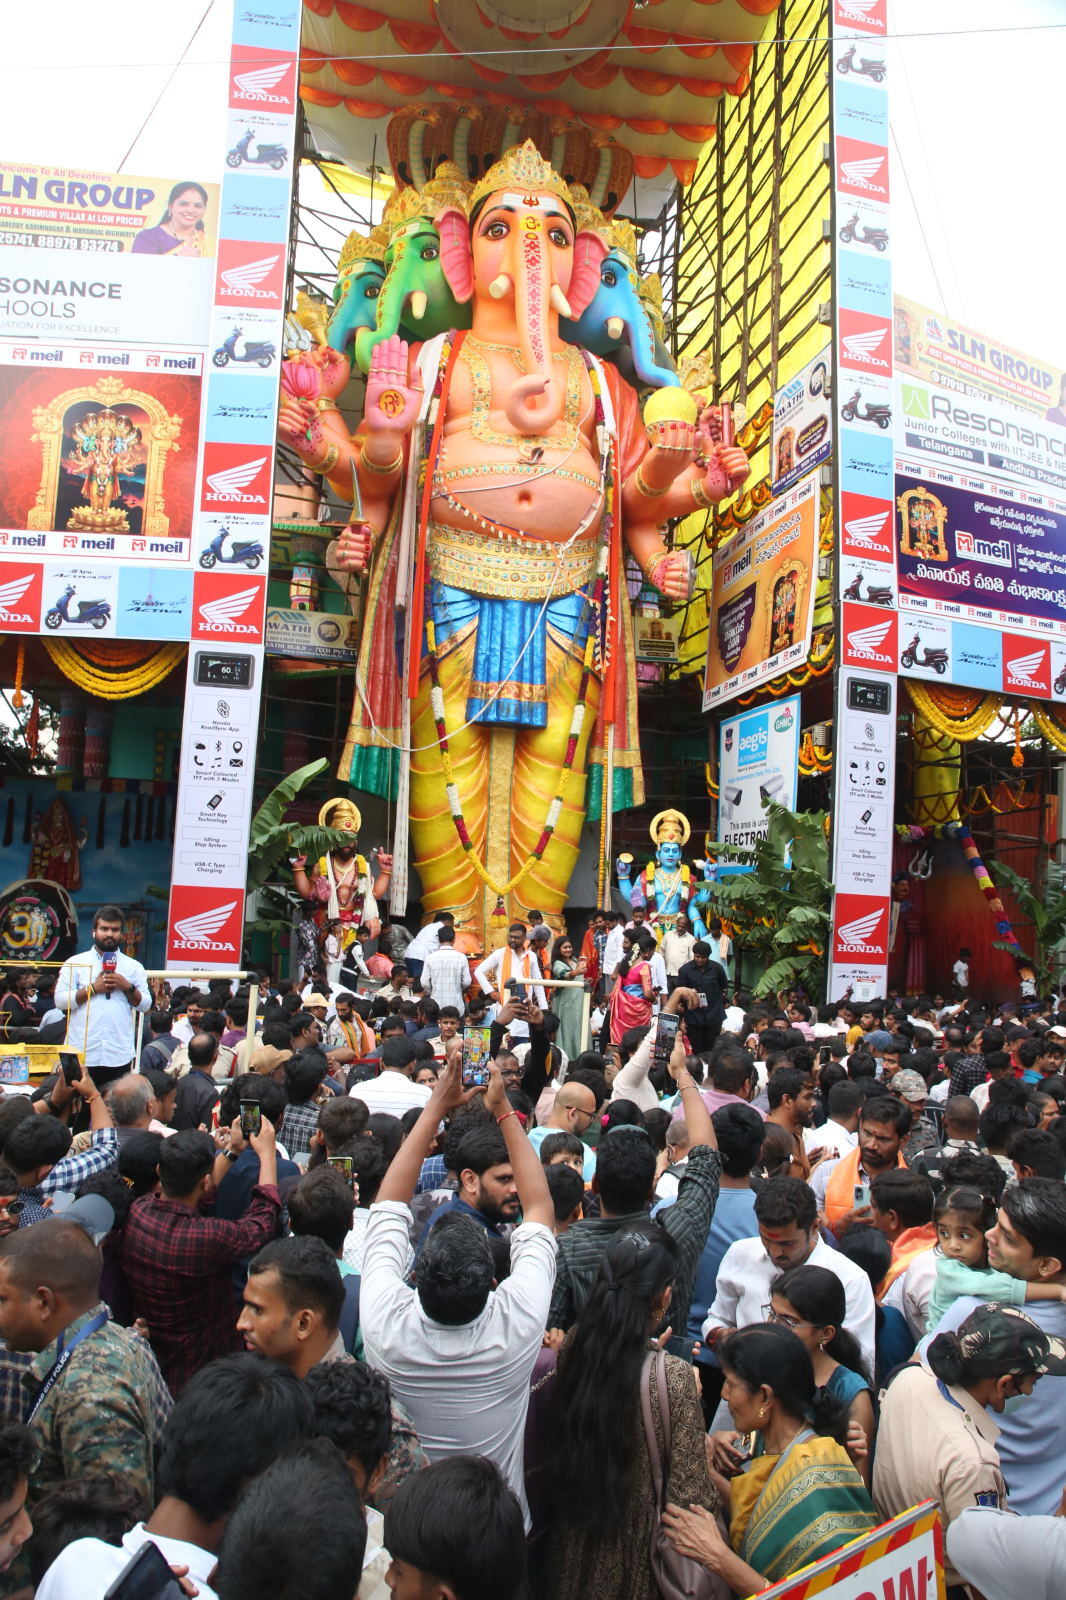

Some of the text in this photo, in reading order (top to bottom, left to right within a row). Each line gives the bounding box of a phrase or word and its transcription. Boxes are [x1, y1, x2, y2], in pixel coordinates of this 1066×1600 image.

[838, 9, 885, 27] HONDA
[232, 90, 291, 104] HONDA
[840, 176, 887, 194] HONDA
[44, 179, 155, 211] GROUP
[13, 207, 19, 216] &
[21, 208, 57, 219] PREMIUM
[60, 210, 86, 221] VILLAS
[98, 213, 115, 223] LOW
[116, 215, 143, 226] PRICES
[219, 287, 280, 299] HONDA
[36, 321, 56, 331] FOR
[58, 323, 121, 335] EXCELLENCE
[30, 350, 196, 370] meil meil meil
[842, 351, 890, 368] HONDA
[947, 328, 986, 363] SLN
[989, 348, 1053, 390] GROUP
[931, 394, 1066, 457] Resonanc
[904, 418, 938, 434] Junior
[941, 426, 987, 447] Colleges
[990, 439, 1010, 454] with
[918, 436, 974, 460] Telangana
[1001, 458, 1035, 479] Andhra
[798, 484, 812, 499] meil
[904, 465, 1043, 505] meil meil meil meil meil
[205, 492, 266, 504] HONDA
[12, 534, 183, 554] meil meil meil
[845, 537, 891, 553] HONDA
[975, 539, 1010, 560] meil
[732, 547, 752, 577] meil
[916, 563, 971, 588] వినాయక
[973, 573, 1004, 593] చవితి
[910, 598, 1054, 630] meil meil meil meil meil
[198, 622, 260, 634] HONDA
[747, 667, 758, 680] meil
[767, 656, 779, 669] meil
[789, 643, 802, 659] meil
[847, 648, 894, 664] HONDA
[221, 666, 231, 674] 60
[1007, 676, 1048, 690] HONDA
[866, 692, 875, 700] 60
[775, 715, 792, 730] GHMC
[739, 727, 768, 752] aegis
[730, 822, 739, 830] This
[740, 821, 751, 829] area
[173, 939, 236, 952] HONDA
[837, 943, 884, 954] HONDA
[43, 1350, 71, 1393] CITY POLICE
